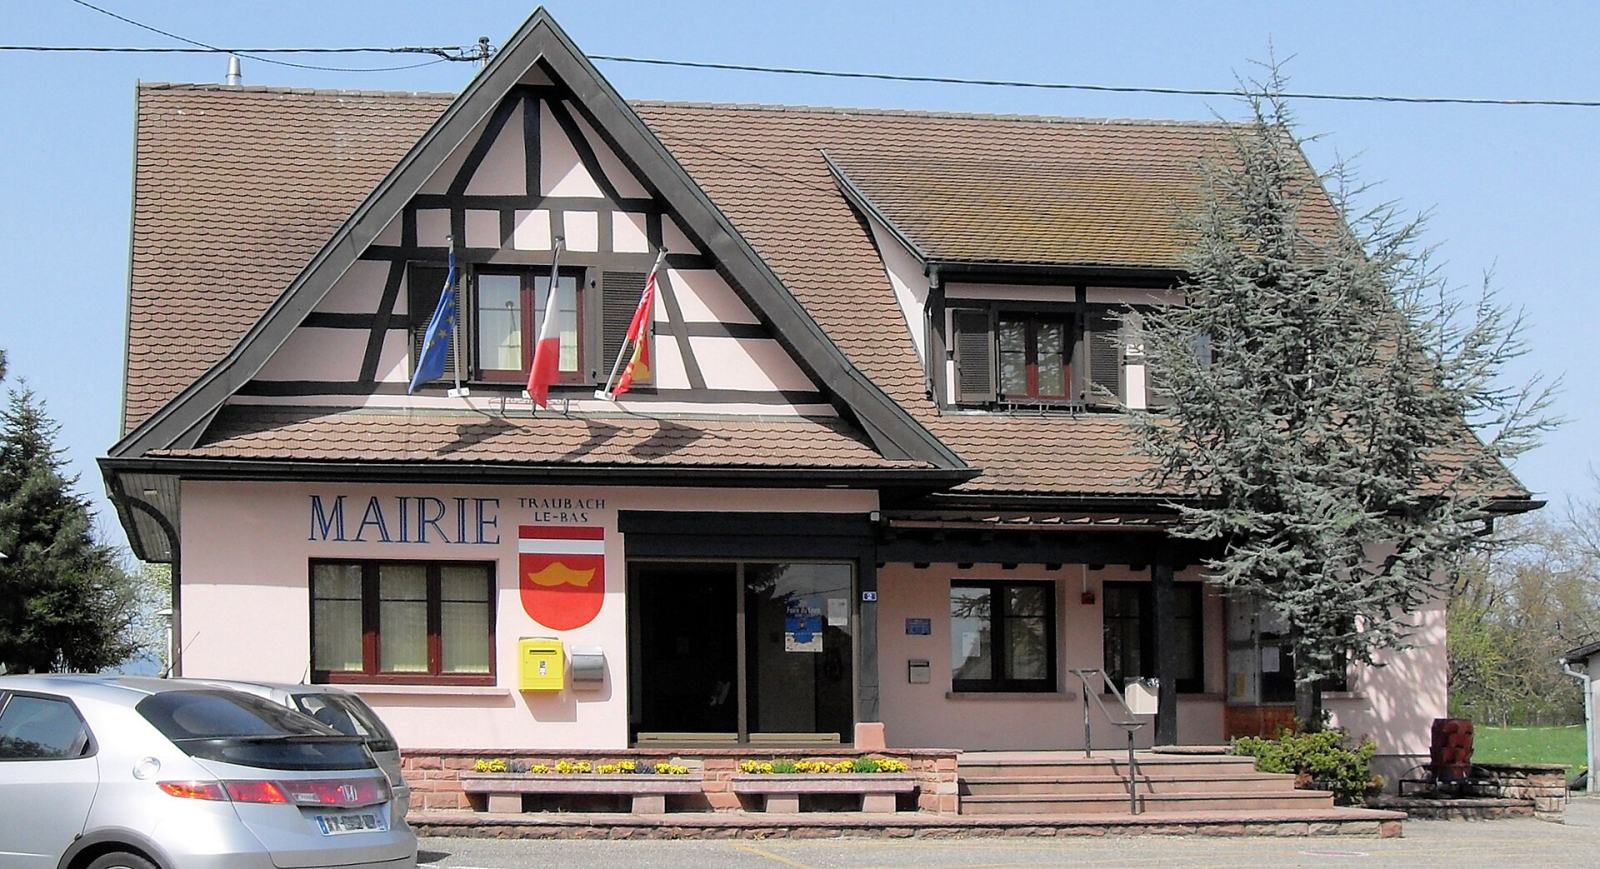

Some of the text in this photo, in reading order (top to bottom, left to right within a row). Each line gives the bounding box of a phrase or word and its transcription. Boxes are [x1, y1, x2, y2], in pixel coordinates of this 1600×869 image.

[518, 497, 605, 509] TRAUBACH
[308, 495, 500, 544] MAIRIE
[534, 511, 589, 522] LE-BAS
